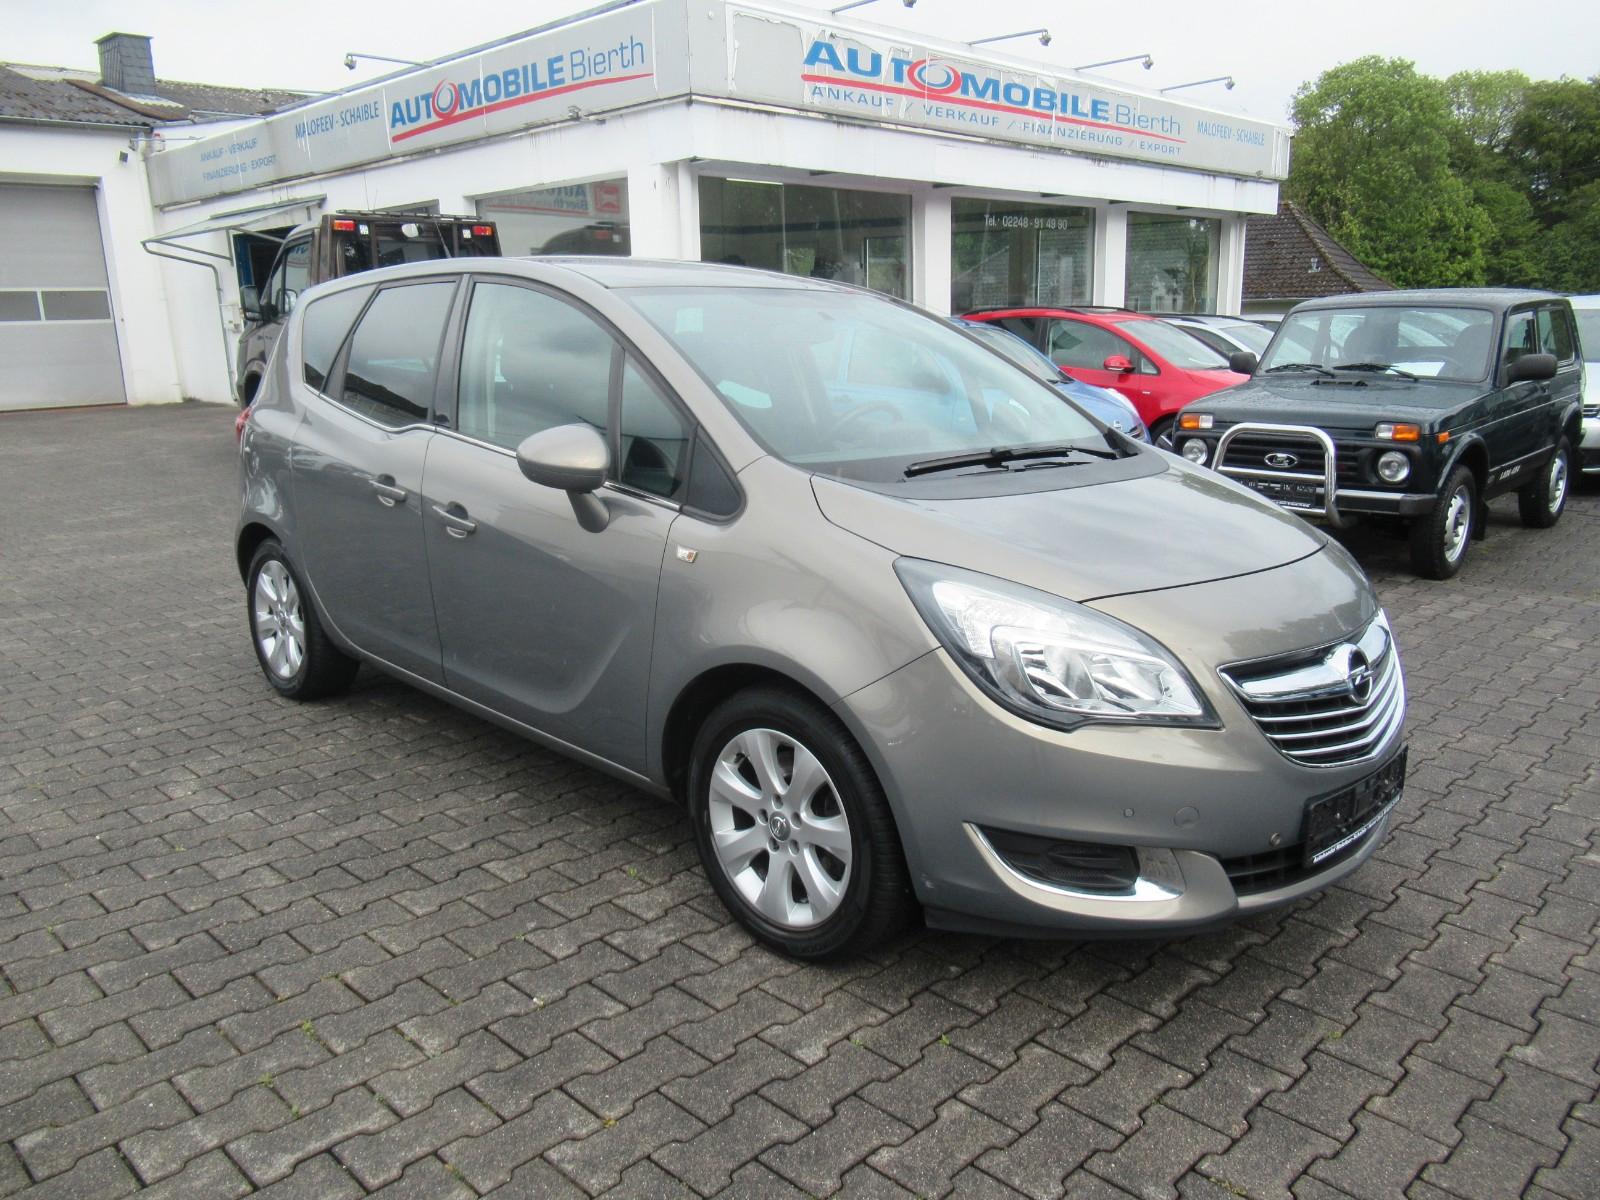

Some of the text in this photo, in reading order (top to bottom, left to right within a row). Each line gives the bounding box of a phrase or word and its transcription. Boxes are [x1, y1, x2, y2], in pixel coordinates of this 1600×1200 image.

[391, 36, 644, 128] AUTOMOBILE Bierth
[803, 40, 1181, 135] AUTOMOBILE Bierth
[295, 113, 334, 138] MALOFEEV
[340, 101, 379, 127] SCHAIBLE
[812, 85, 894, 107] ANKAUF
[923, 104, 999, 126] VERKAUF
[1023, 121, 1122, 146] FINANZIERUNG
[1140, 141, 1181, 155] EXPORT
[1197, 119, 1232, 139] MALOFEEV
[1237, 128, 1265, 146] SCHAIBLE
[228, 138, 257, 154] VERKAUF
[251, 154, 276, 170] EXPORT
[1002, 216, 1029, 228] 02248
[1034, 217, 1044, 229] 91
[1045, 218, 1056, 229] 49
